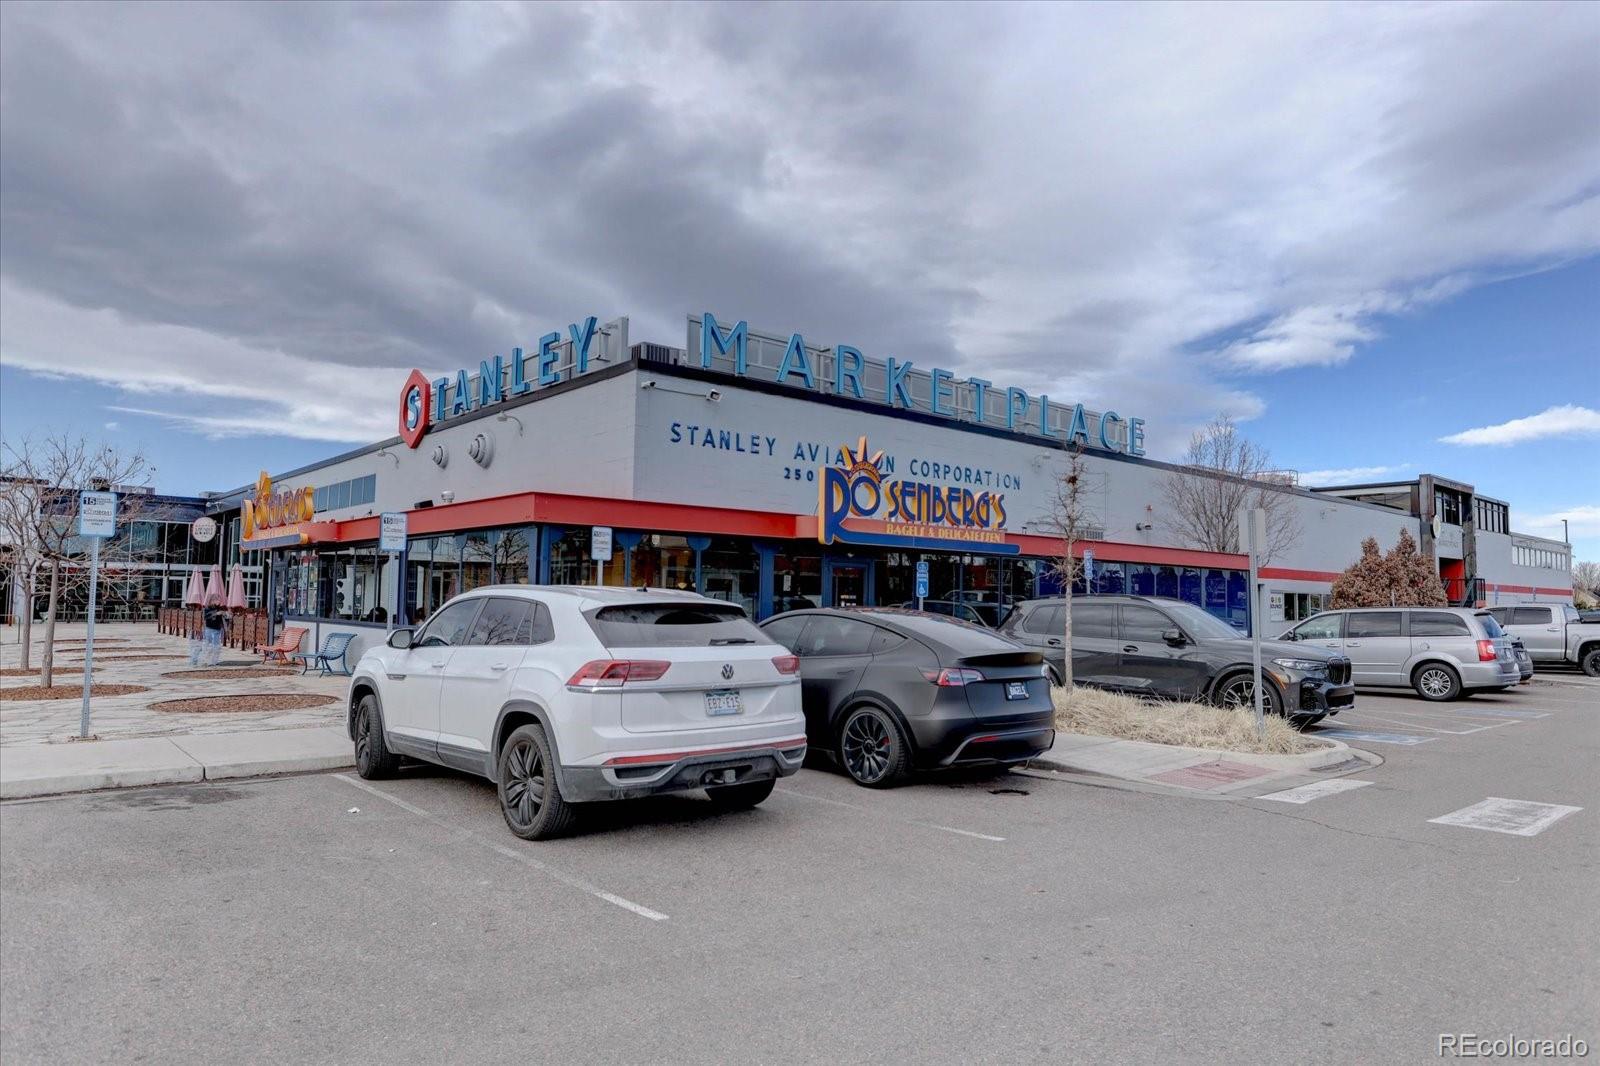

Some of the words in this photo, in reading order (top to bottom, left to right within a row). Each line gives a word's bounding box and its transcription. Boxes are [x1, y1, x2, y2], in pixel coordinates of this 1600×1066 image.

[405, 316, 597, 430] STANLEY
[701, 312, 1146, 456] MARKETPLACE
[670, 422, 776, 456] STANLEY
[793, 441, 895, 473] AVIAN
[909, 459, 1021, 490] CORPORATION
[818, 464, 1007, 545] ROSENBERG'S
[886, 523, 925, 537] BAGELS
[928, 527, 936, 537] &
